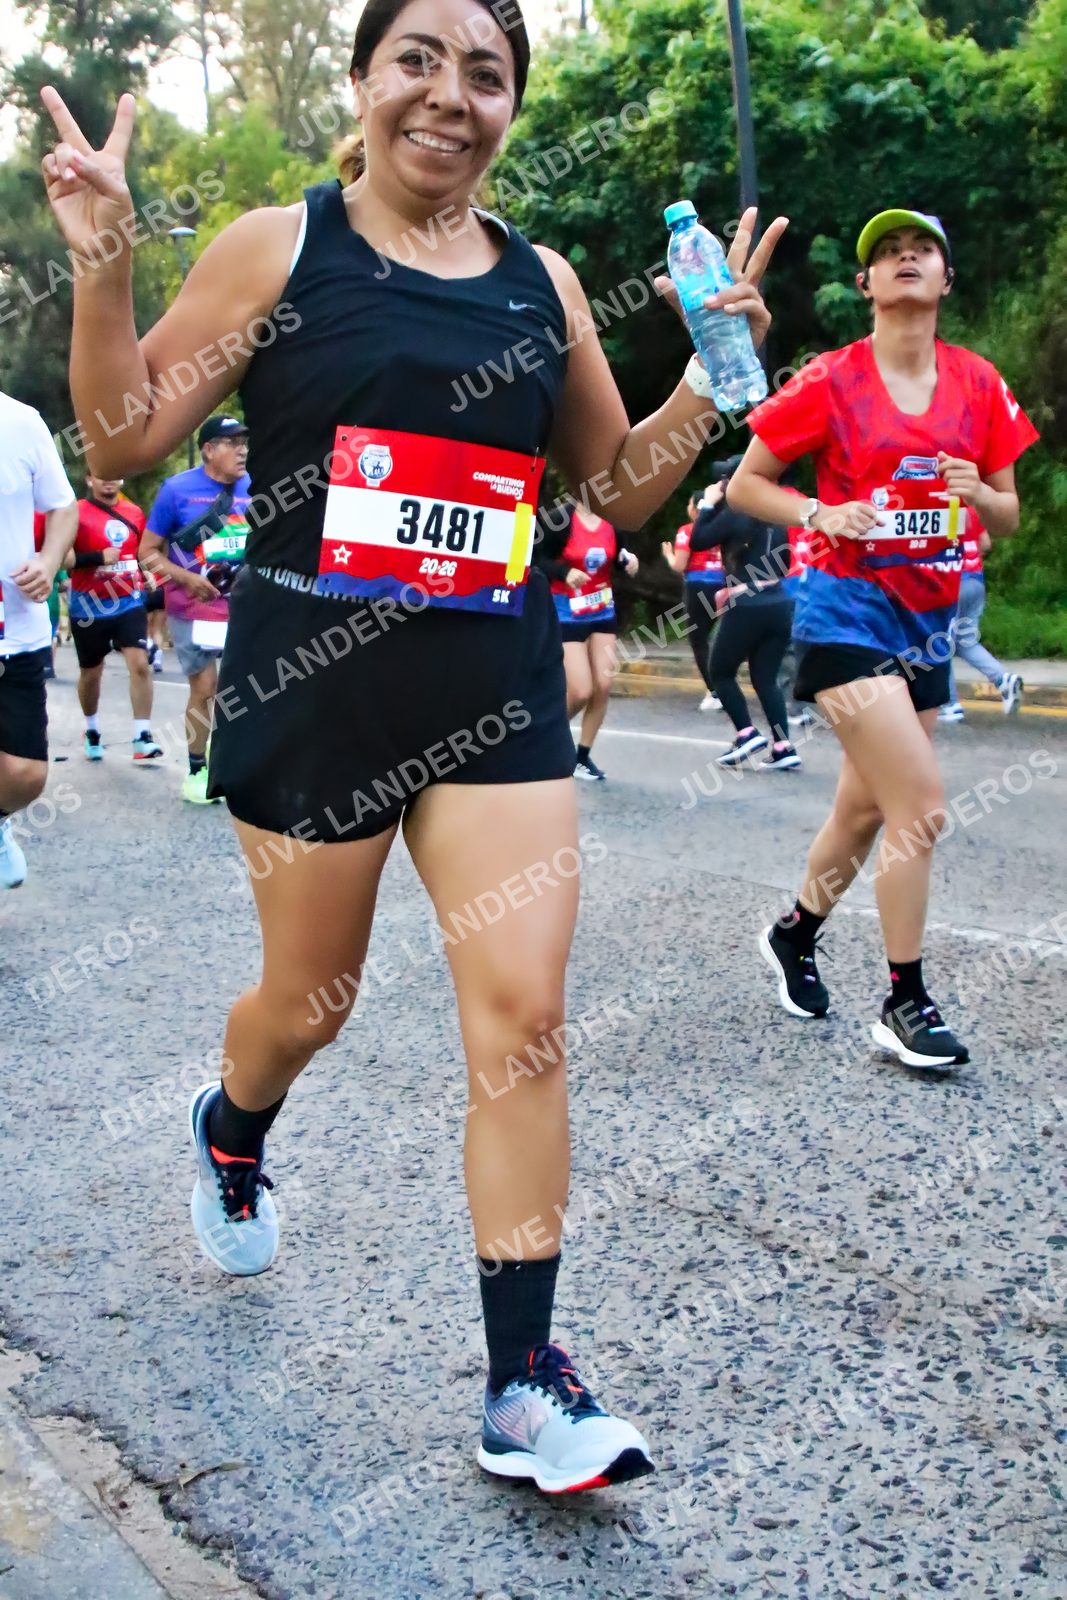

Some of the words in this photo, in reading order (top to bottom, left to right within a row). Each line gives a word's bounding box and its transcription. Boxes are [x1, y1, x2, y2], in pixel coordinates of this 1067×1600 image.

[396, 498, 485, 554] 3481
[894, 511, 941, 536] 3426
[492, 589, 509, 603] 5K
